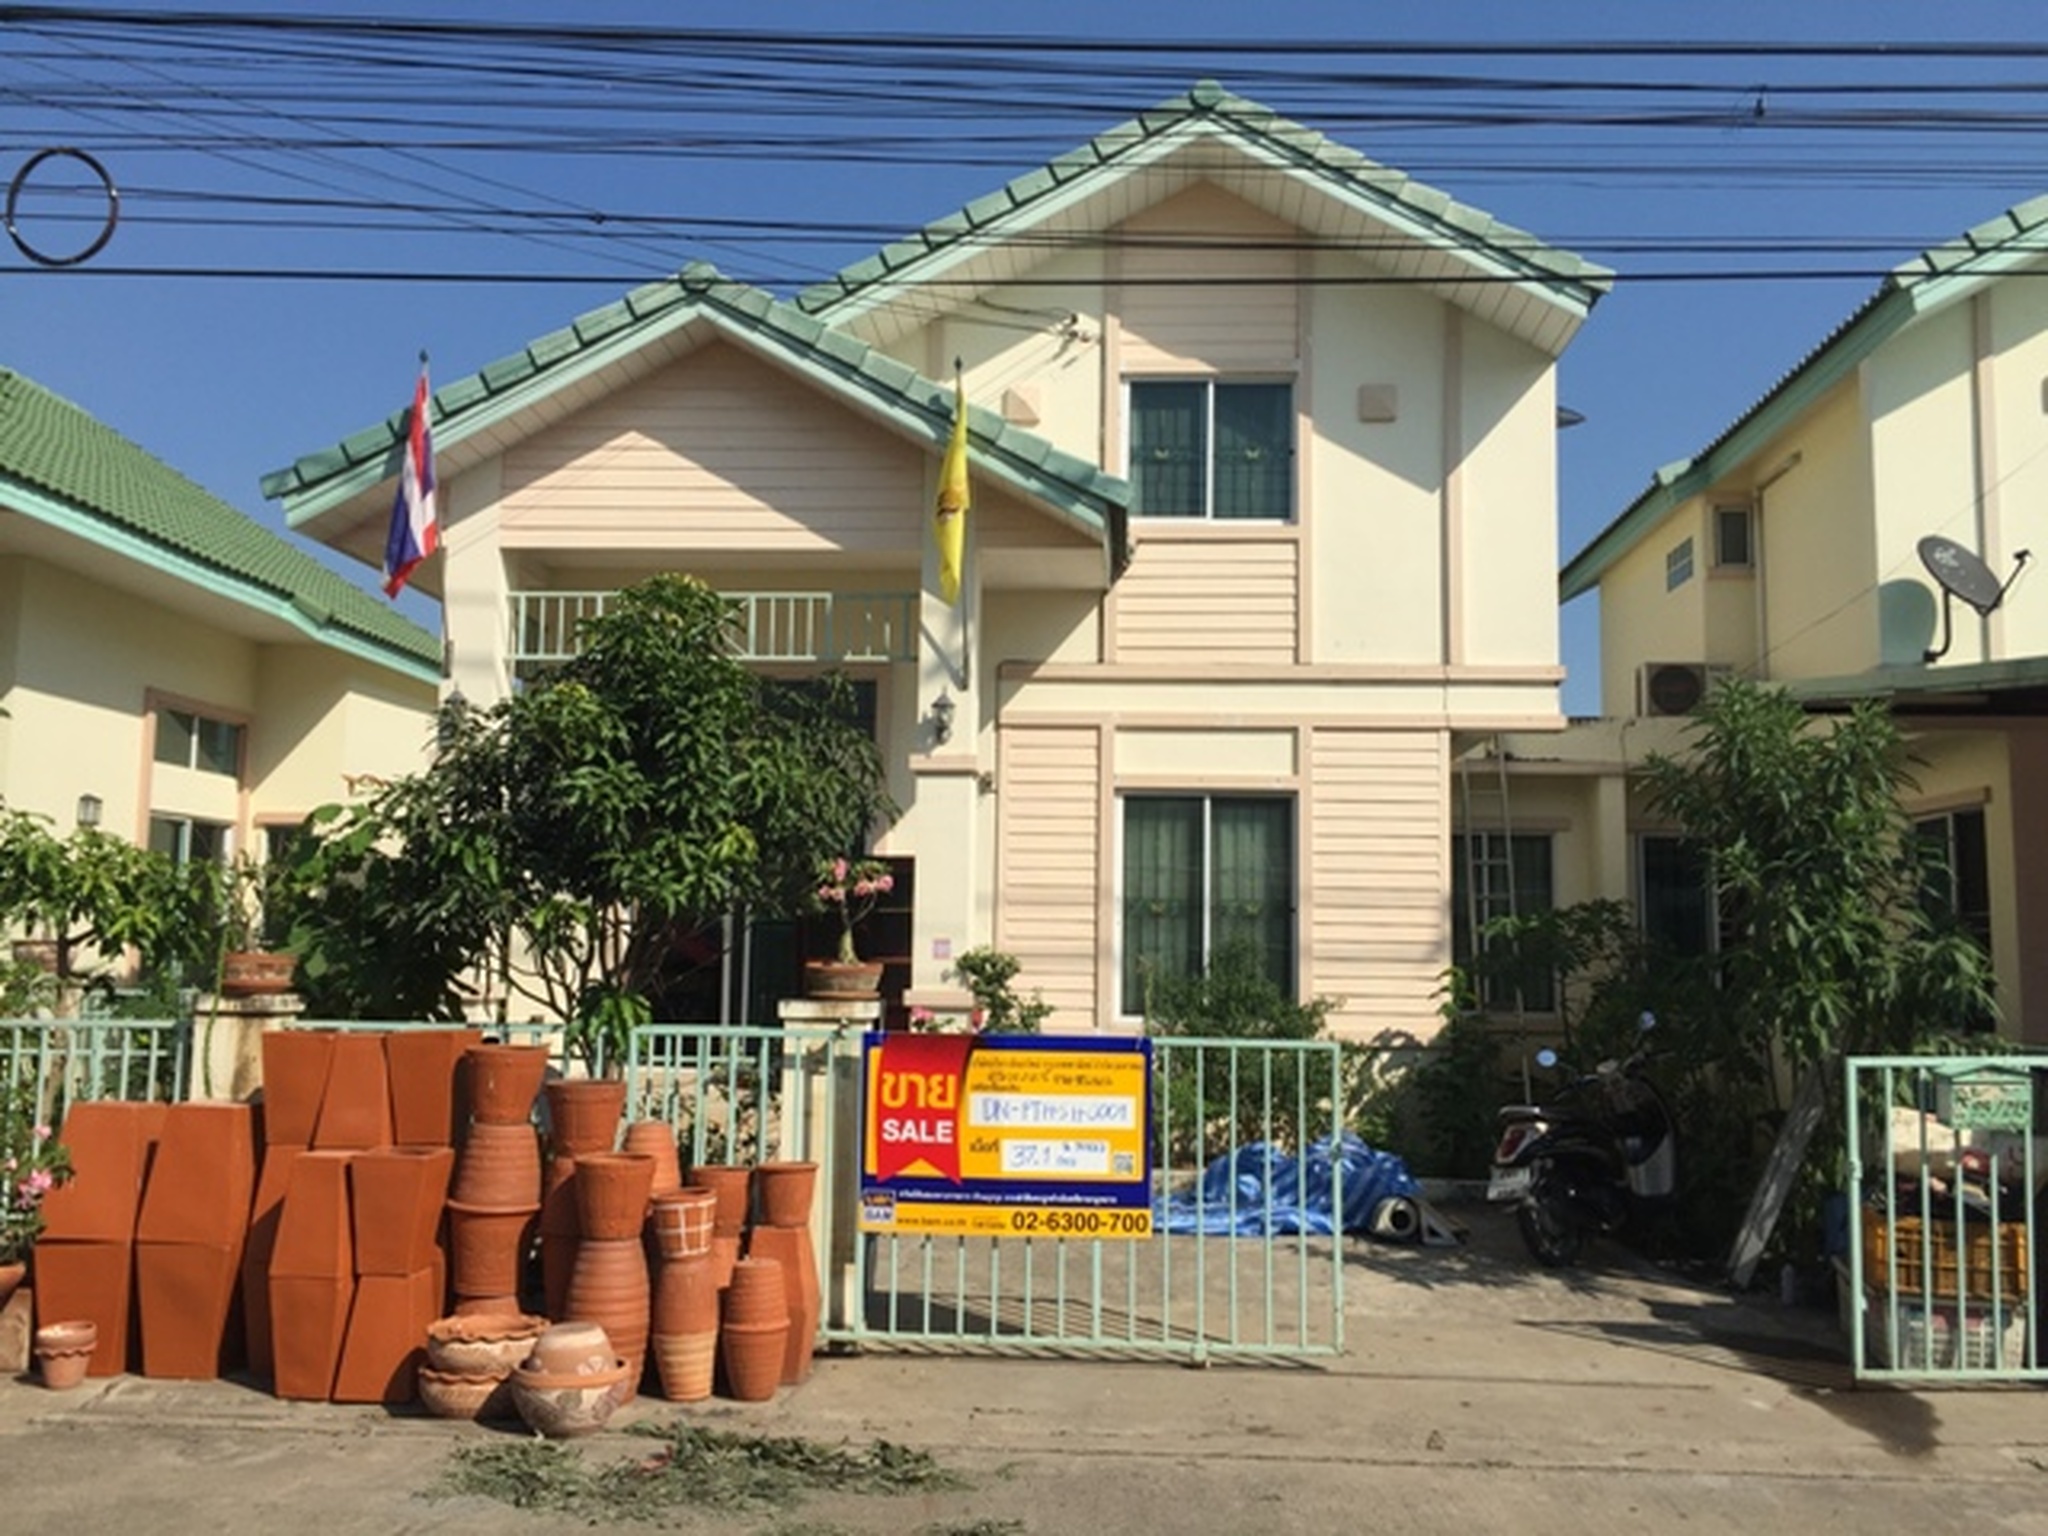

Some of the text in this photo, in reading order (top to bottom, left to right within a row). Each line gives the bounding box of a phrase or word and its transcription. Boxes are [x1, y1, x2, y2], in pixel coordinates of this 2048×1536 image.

[882, 1071, 956, 1108] ขาย
[882, 1118, 954, 1144] SALE
[1011, 1210, 1149, 1233] 02-6300-700
